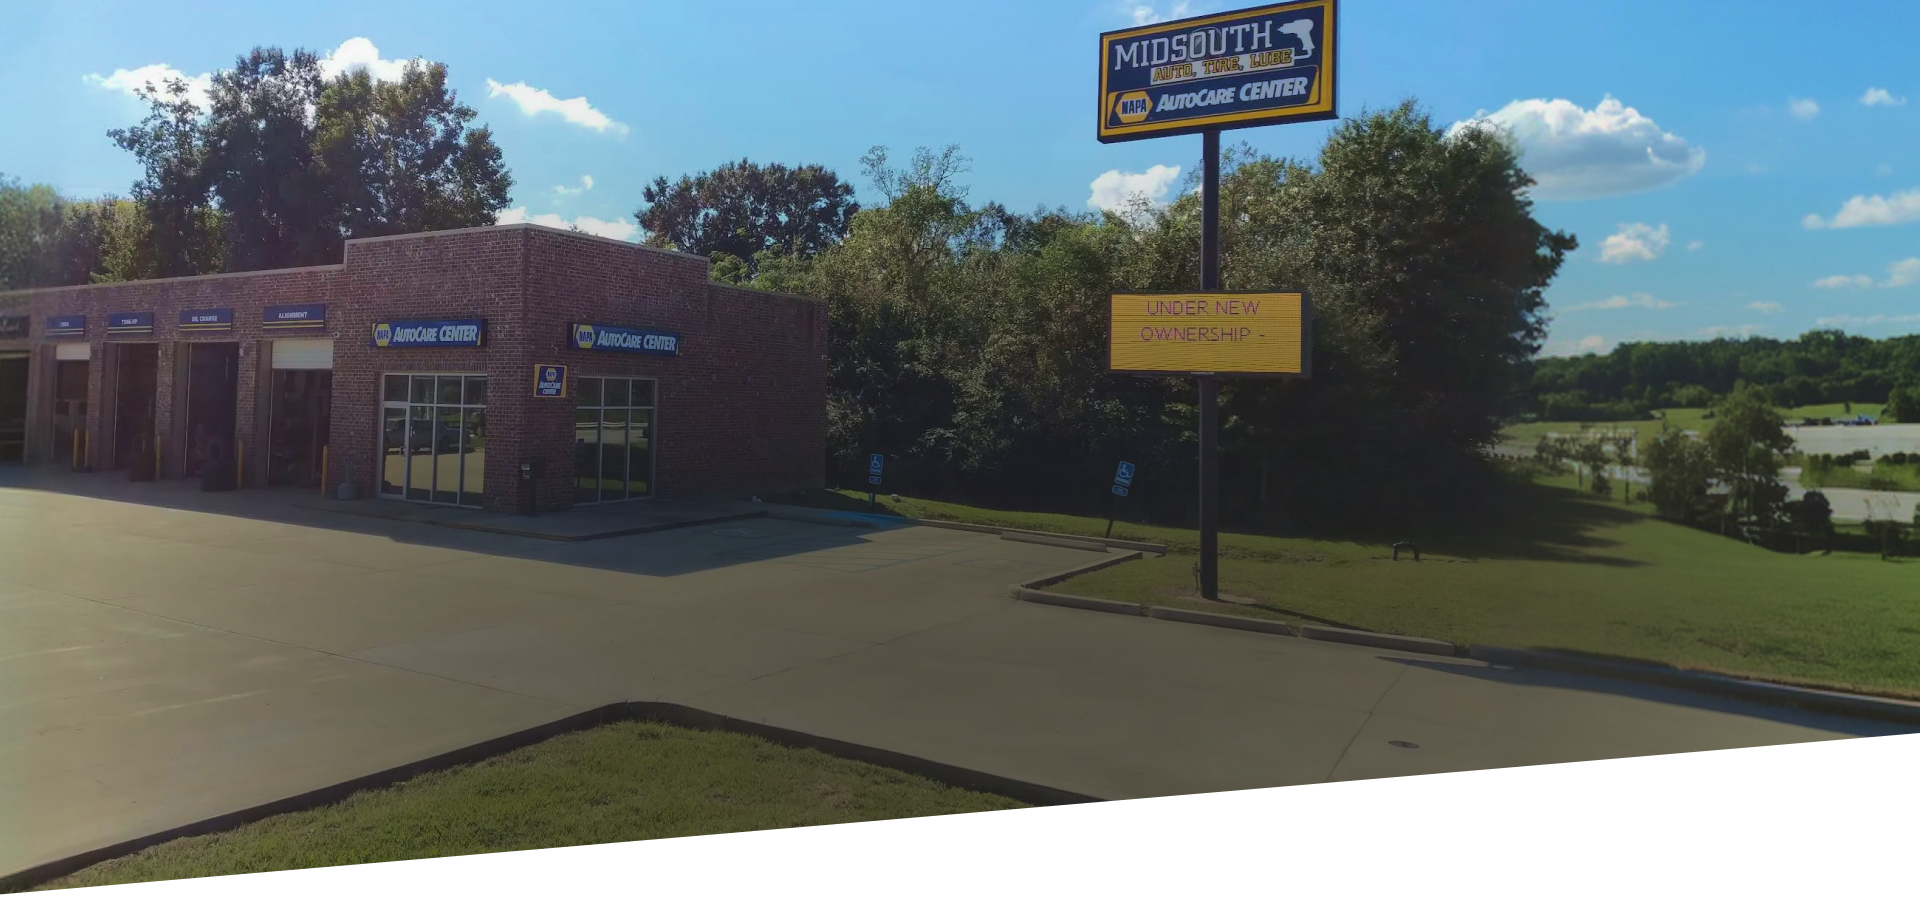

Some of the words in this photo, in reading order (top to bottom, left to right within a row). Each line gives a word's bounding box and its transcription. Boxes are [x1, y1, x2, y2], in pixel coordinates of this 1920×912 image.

[1114, 20, 1273, 71] MIDSOUTH
[1153, 62, 1197, 81] AUTO,
[1203, 56, 1244, 75] TIRE,
[1250, 49, 1293, 68] LUBE
[1121, 98, 1147, 115] NAPA
[1239, 76, 1308, 102] CENTER
[278, 311, 308, 319] ALIGNMENT
[1146, 300, 1209, 315] UNDER
[1215, 300, 1260, 315] NEW
[440, 325, 478, 342] CENTER
[1140, 326, 1251, 342] OWNERSHIP
[643, 334, 676, 351] CENTER
